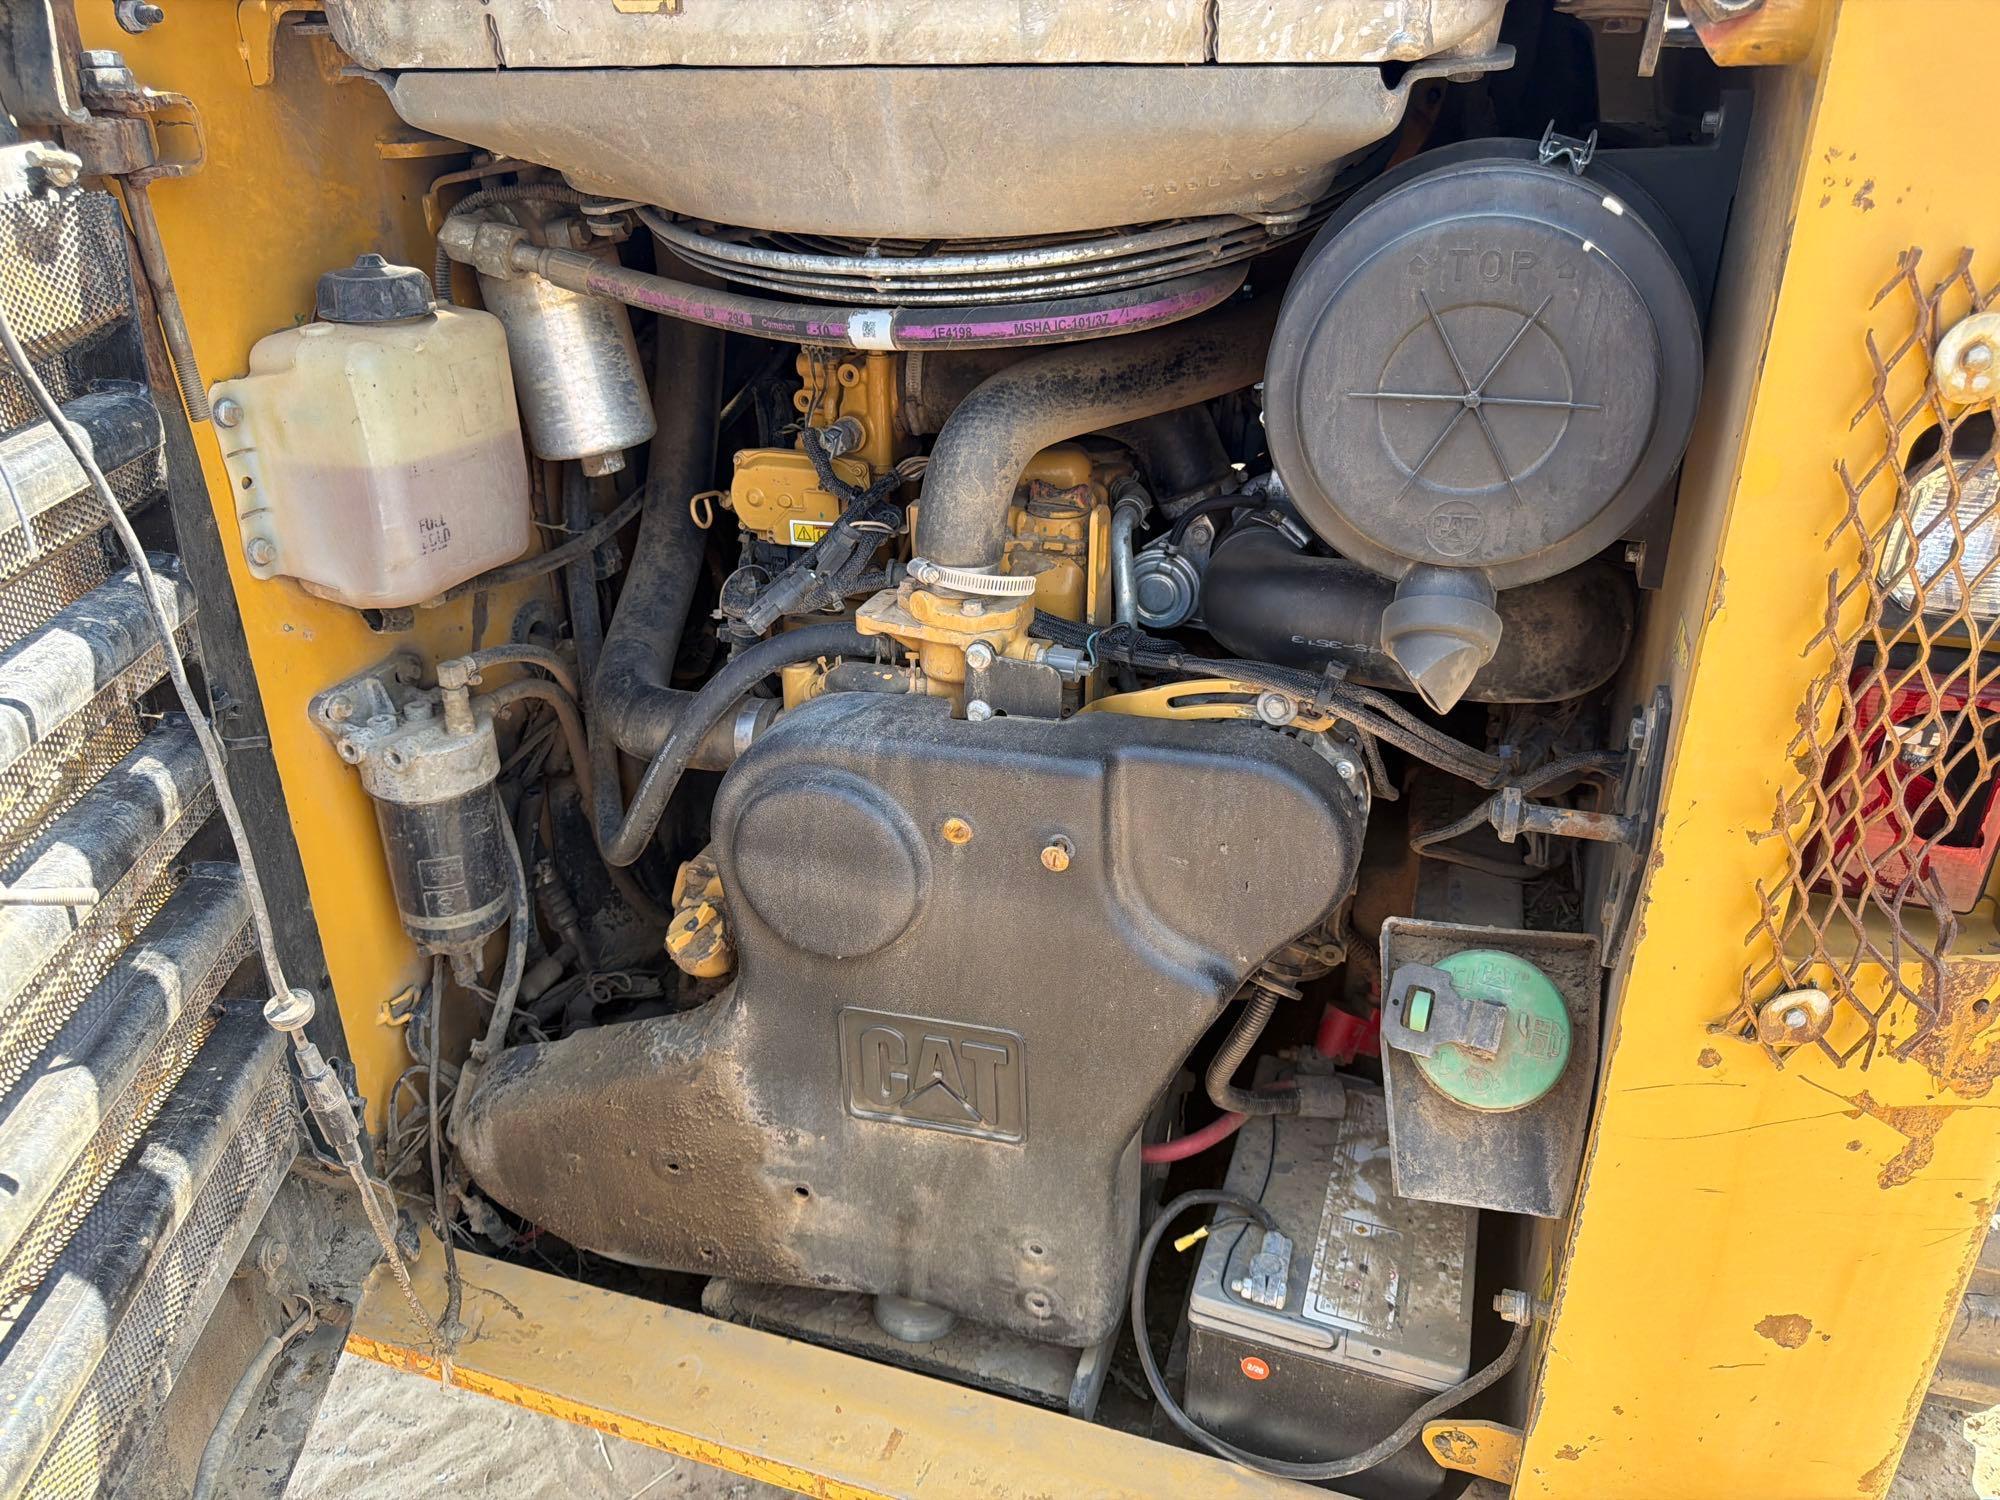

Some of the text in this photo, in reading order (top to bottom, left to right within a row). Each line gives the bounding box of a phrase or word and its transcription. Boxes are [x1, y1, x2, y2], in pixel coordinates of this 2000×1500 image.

[1449, 249, 1539, 284] TOP
[1014, 320, 1052, 336] MSHA
[860, 1024, 1009, 1126] CAT
